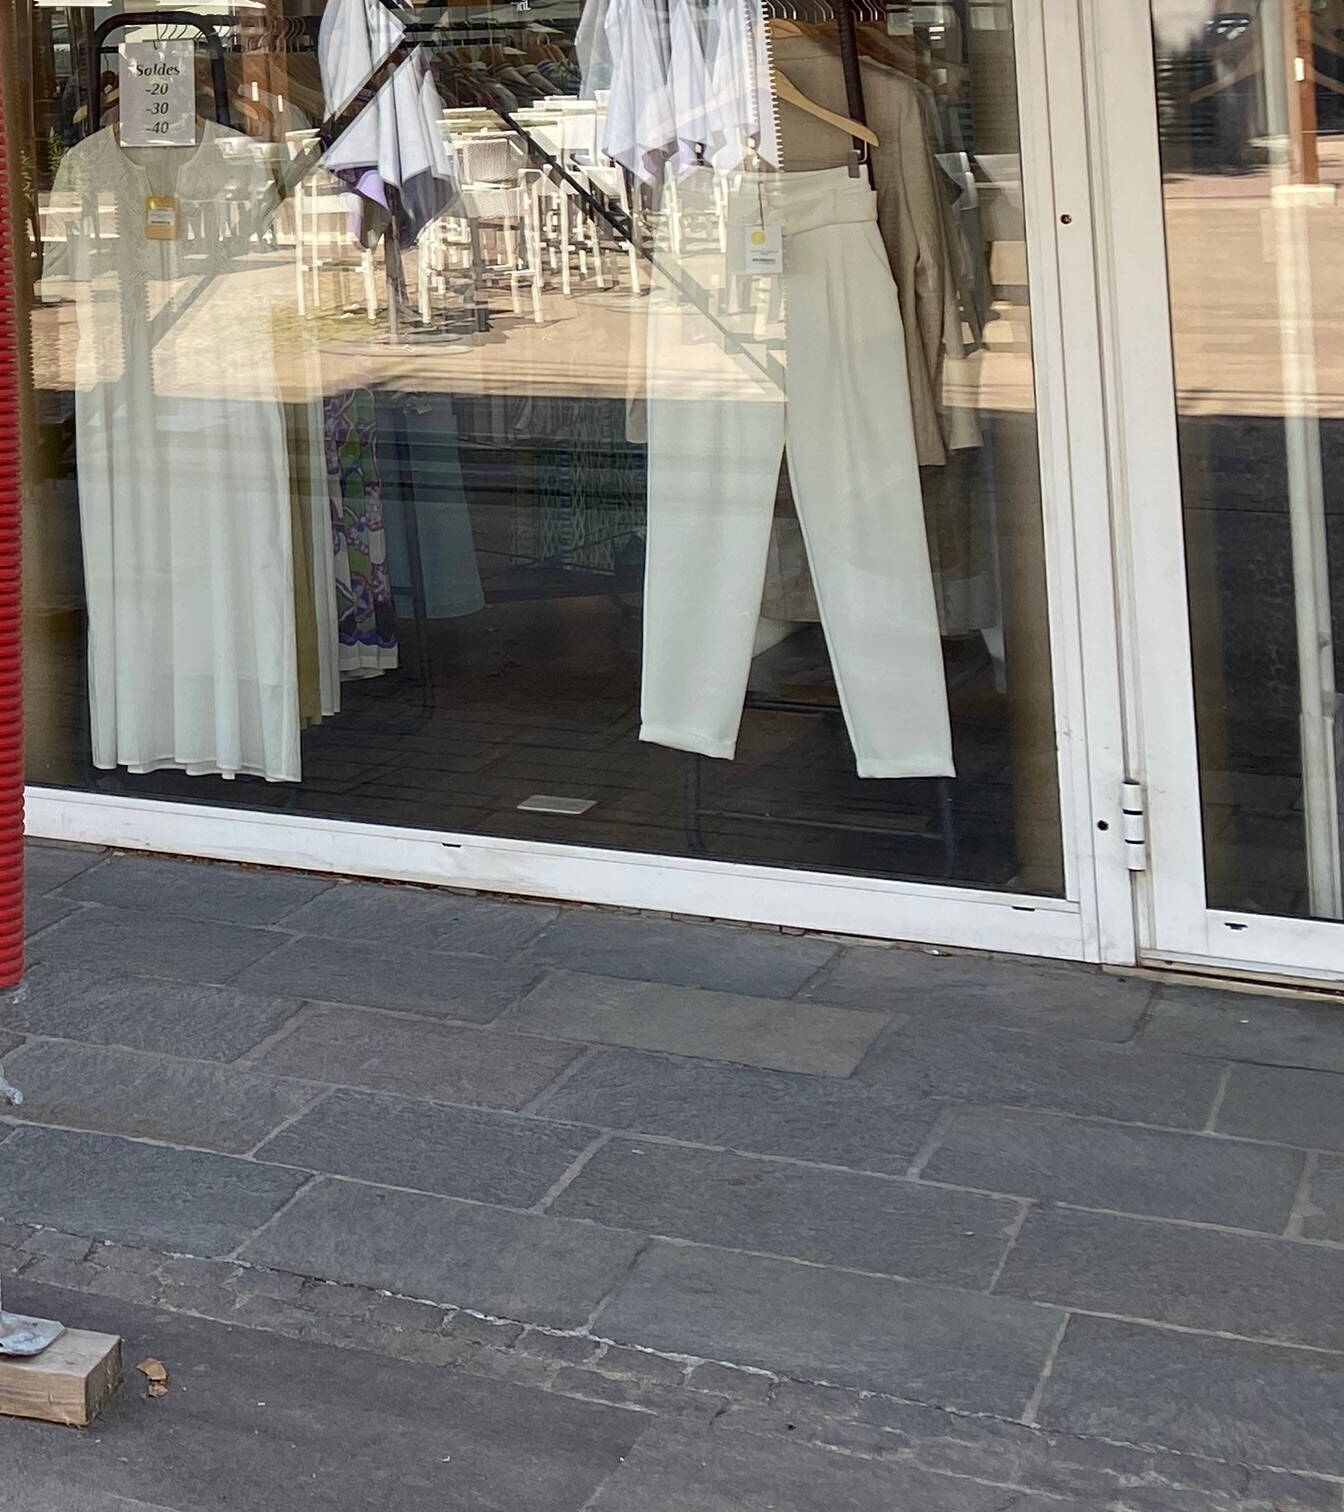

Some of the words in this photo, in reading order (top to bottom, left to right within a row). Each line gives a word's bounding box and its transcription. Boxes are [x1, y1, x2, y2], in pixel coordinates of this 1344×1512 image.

[136, 63, 181, 77] Soldes
[145, 83, 169, 96] -20
[145, 102, 169, 115] -30
[145, 122, 169, 134] -40
